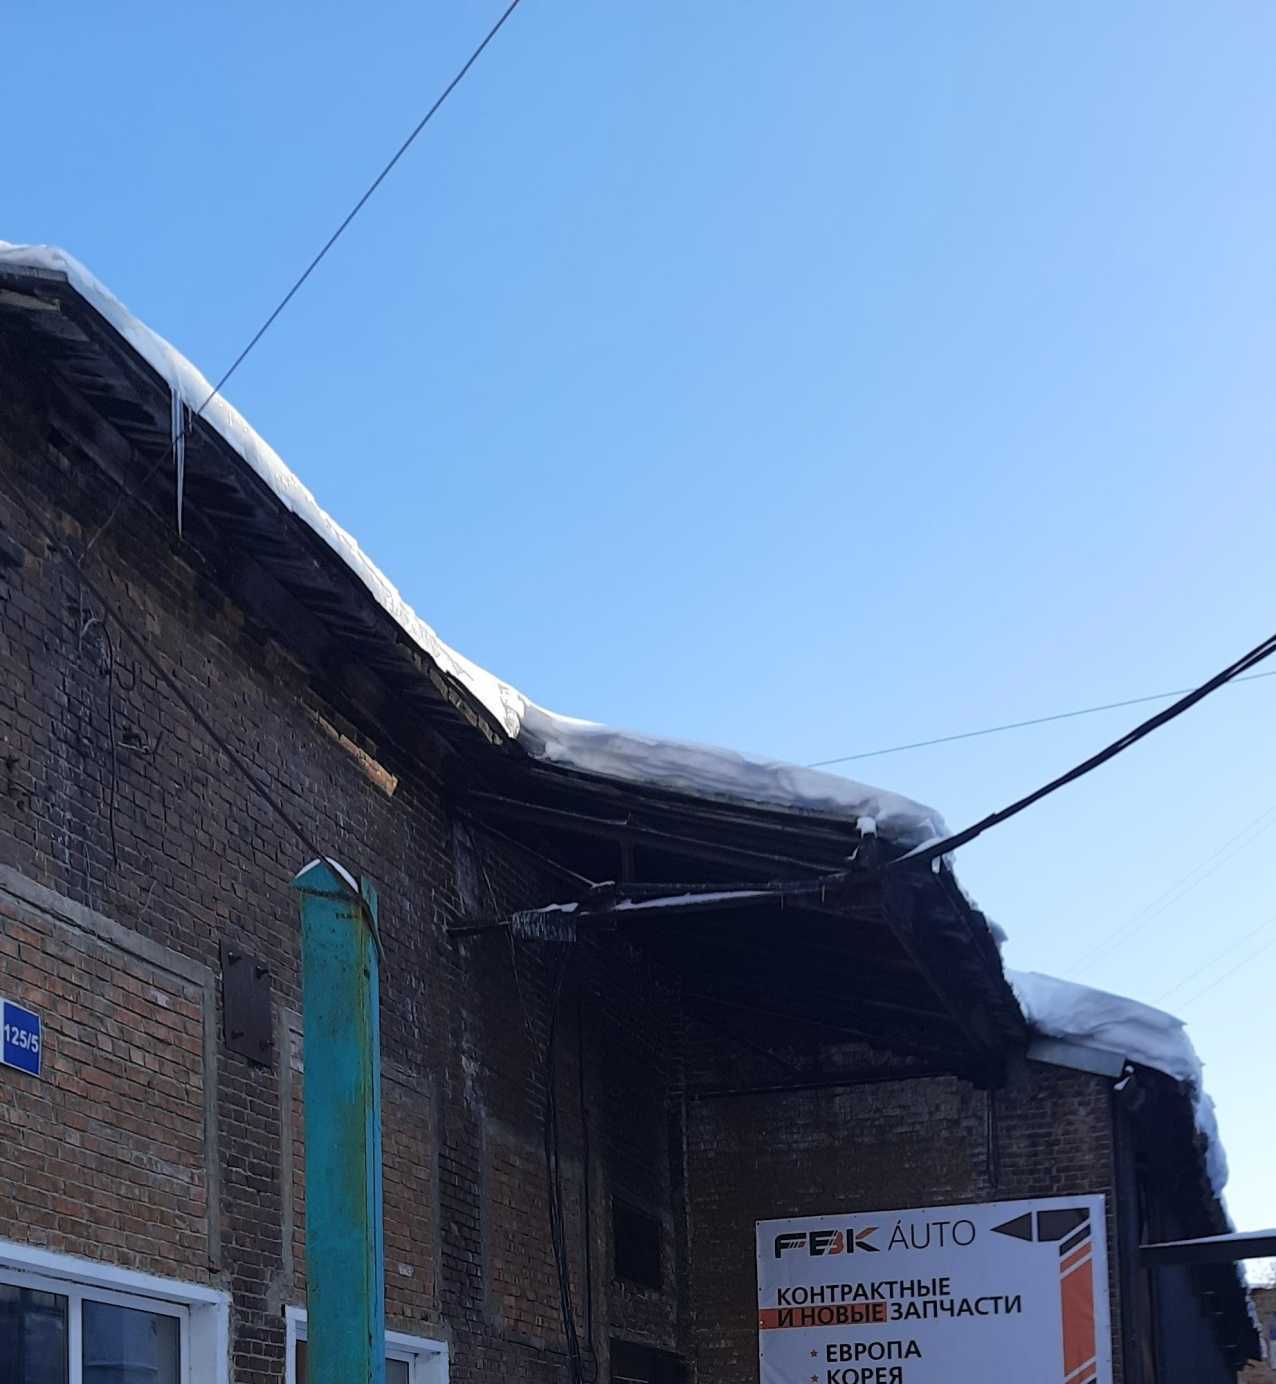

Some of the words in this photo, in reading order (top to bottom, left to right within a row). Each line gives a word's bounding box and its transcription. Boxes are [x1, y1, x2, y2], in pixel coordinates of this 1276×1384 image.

[4, 1023, 39, 1053] 125/5
[777, 1277, 951, 1306] КОНТРАКТНЫЕ
[777, 1308, 793, 1328] И
[801, 1302, 884, 1325] НОВЫЕ
[890, 1295, 1022, 1321] ЗАПЧАСТИ
[826, 1340, 922, 1363] ЕВРОПА
